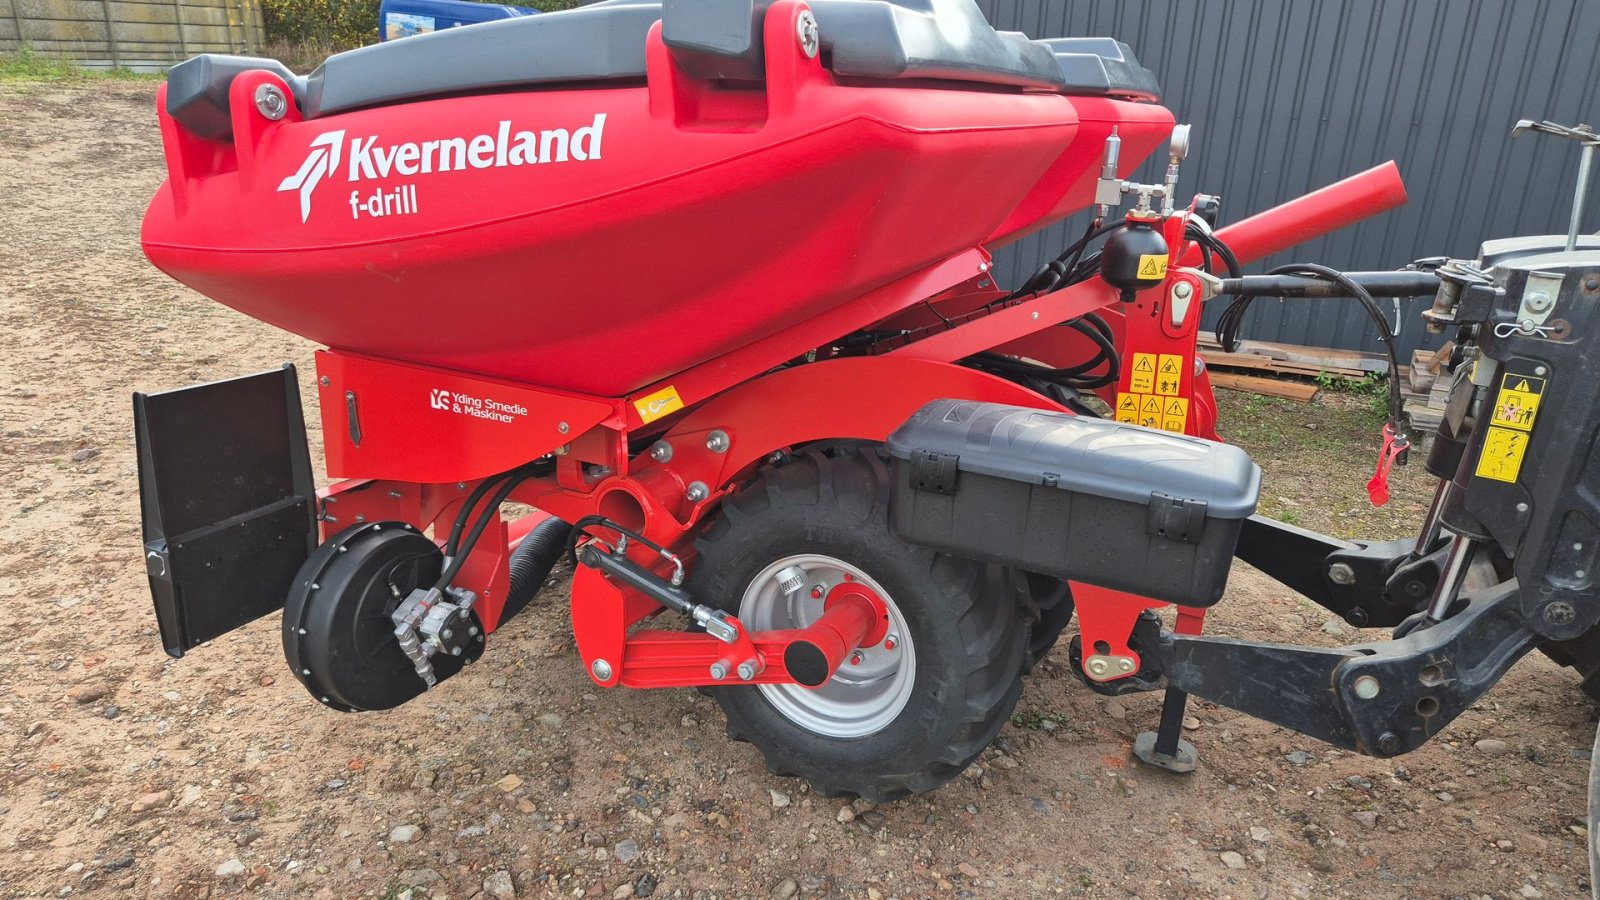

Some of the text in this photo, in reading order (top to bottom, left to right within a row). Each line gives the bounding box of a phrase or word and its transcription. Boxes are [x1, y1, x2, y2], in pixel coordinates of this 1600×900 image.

[348, 113, 607, 182] Kverneland
[349, 184, 418, 220] f-drill
[452, 392, 528, 416] Yding Smedie
[453, 403, 514, 423] & Maskiner
